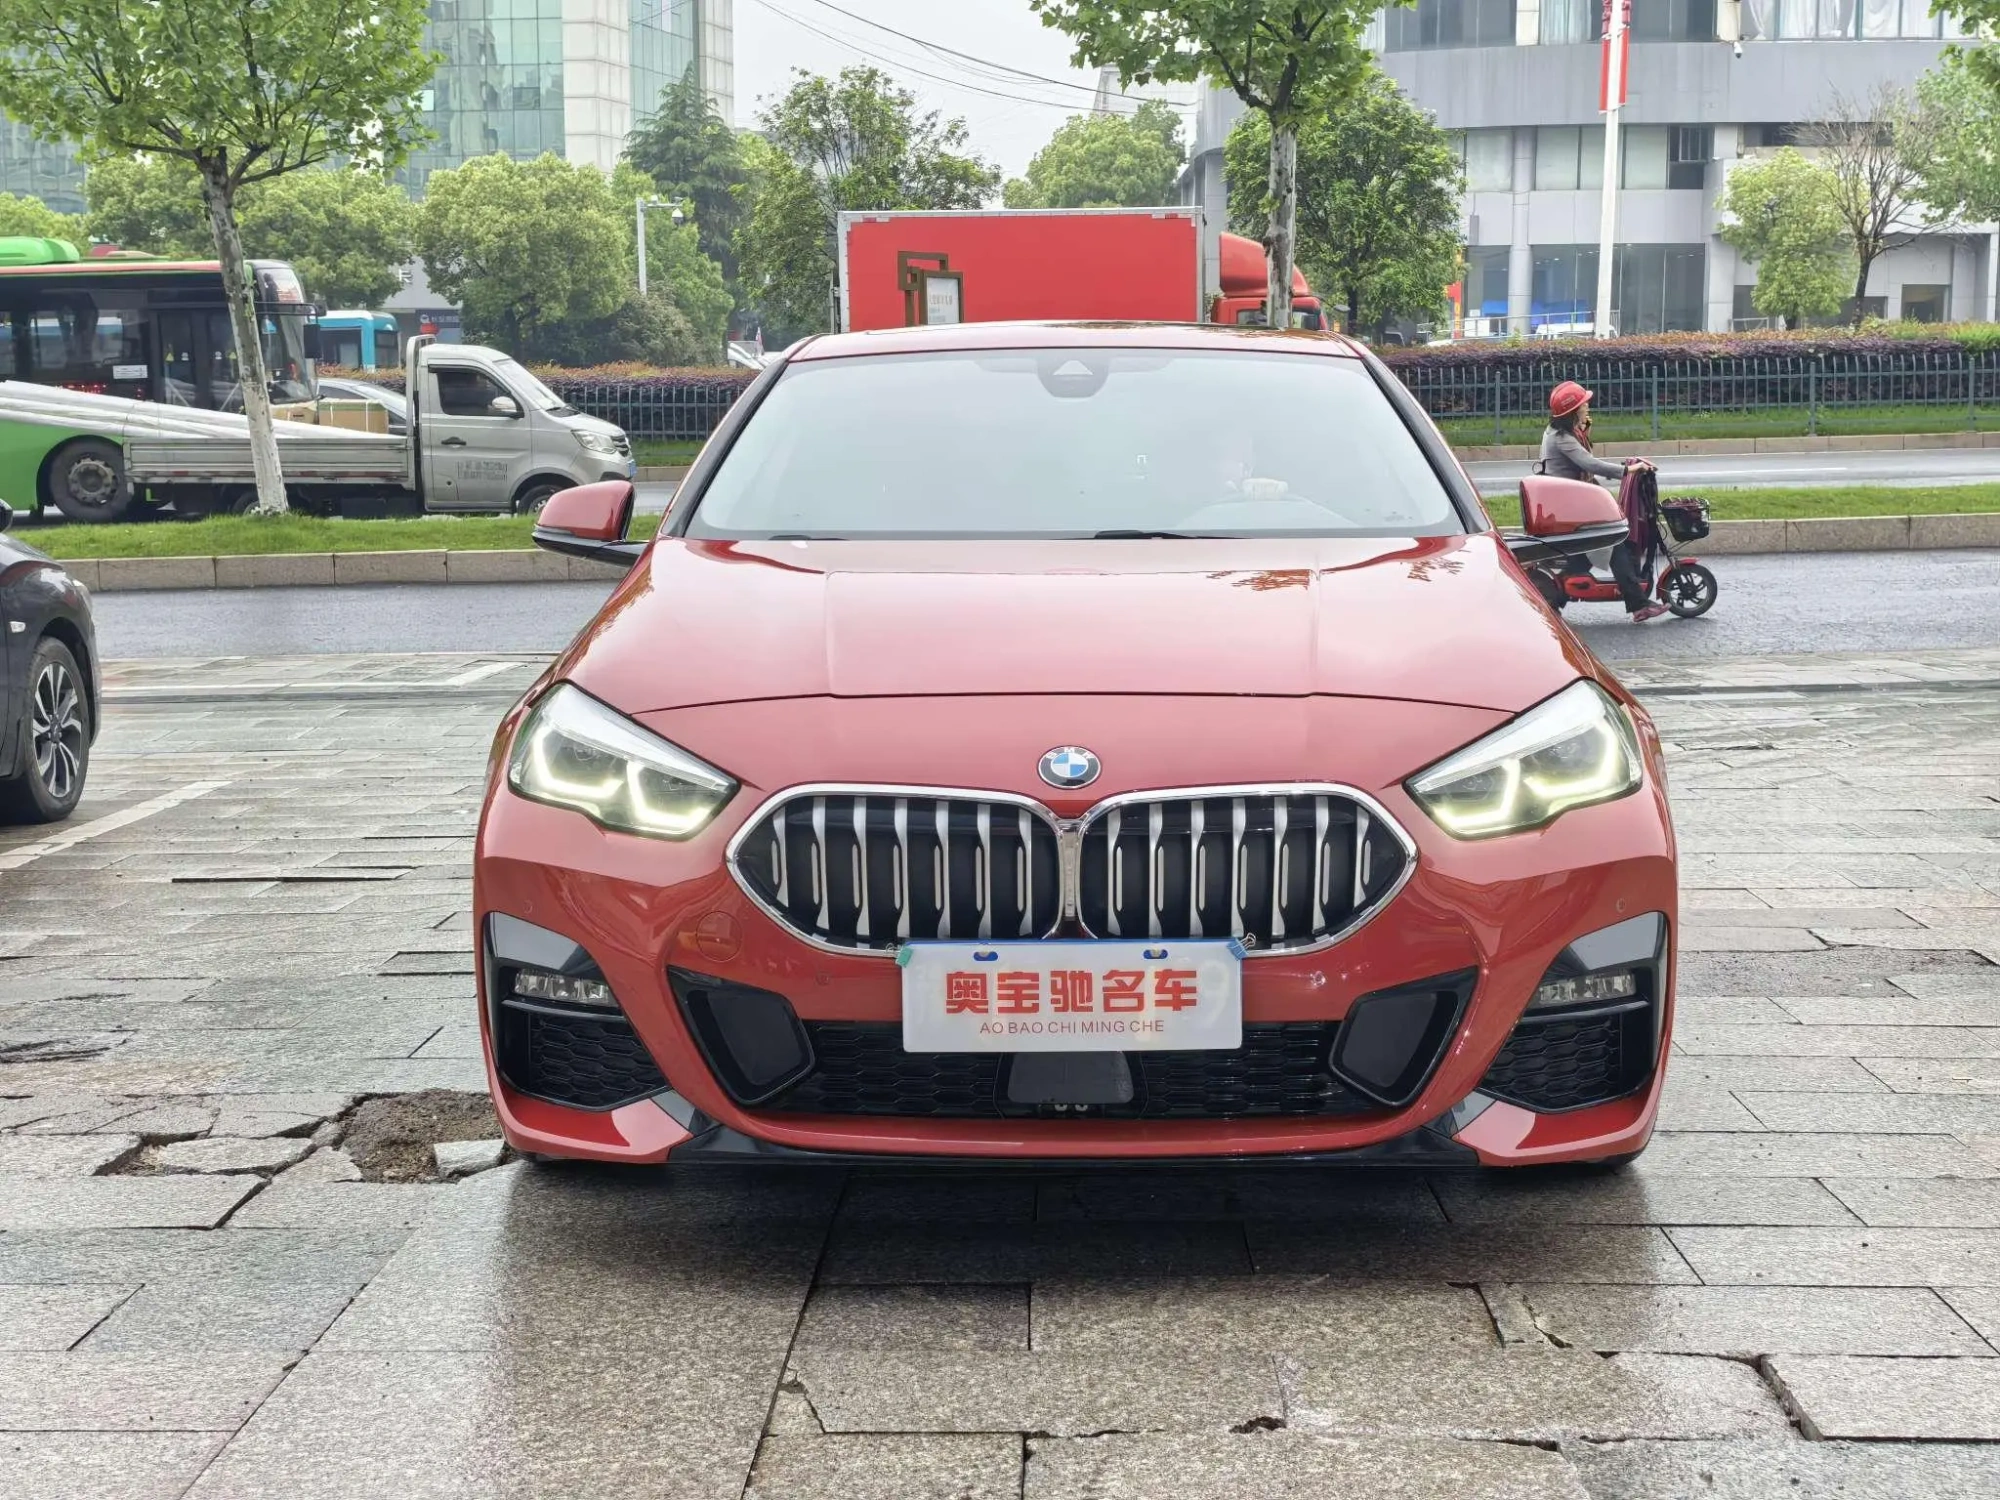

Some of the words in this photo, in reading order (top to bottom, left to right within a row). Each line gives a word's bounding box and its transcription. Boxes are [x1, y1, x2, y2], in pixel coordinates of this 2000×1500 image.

[1045, 747, 1095, 760] BMW
[945, 969, 1198, 1014] 奥宝驰名车
[979, 1022, 1003, 1034] AO
[1008, 1021, 1043, 1034] BAO
[1047, 1021, 1076, 1033] CHI
[1081, 1020, 1125, 1033] MING
[1129, 1019, 1164, 1032] CHE
